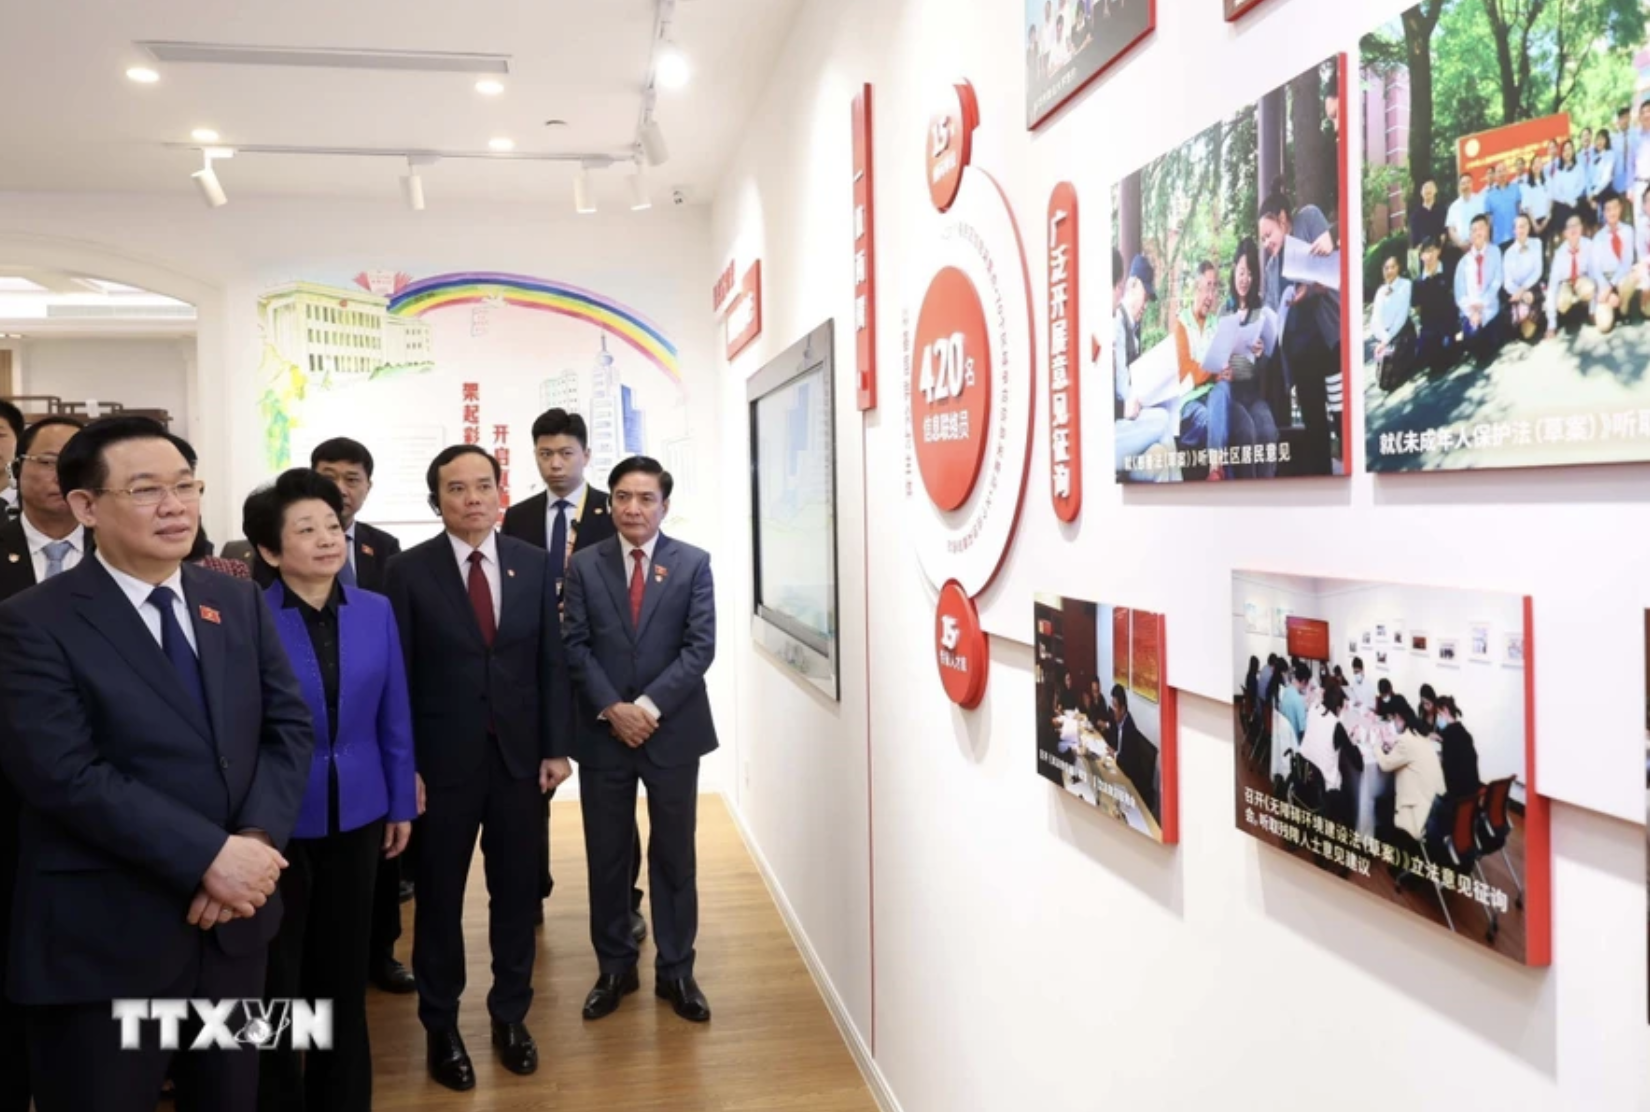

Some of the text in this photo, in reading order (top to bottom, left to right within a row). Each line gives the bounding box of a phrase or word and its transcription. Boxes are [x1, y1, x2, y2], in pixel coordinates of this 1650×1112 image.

[923, 409, 970, 442] 信息联络员
